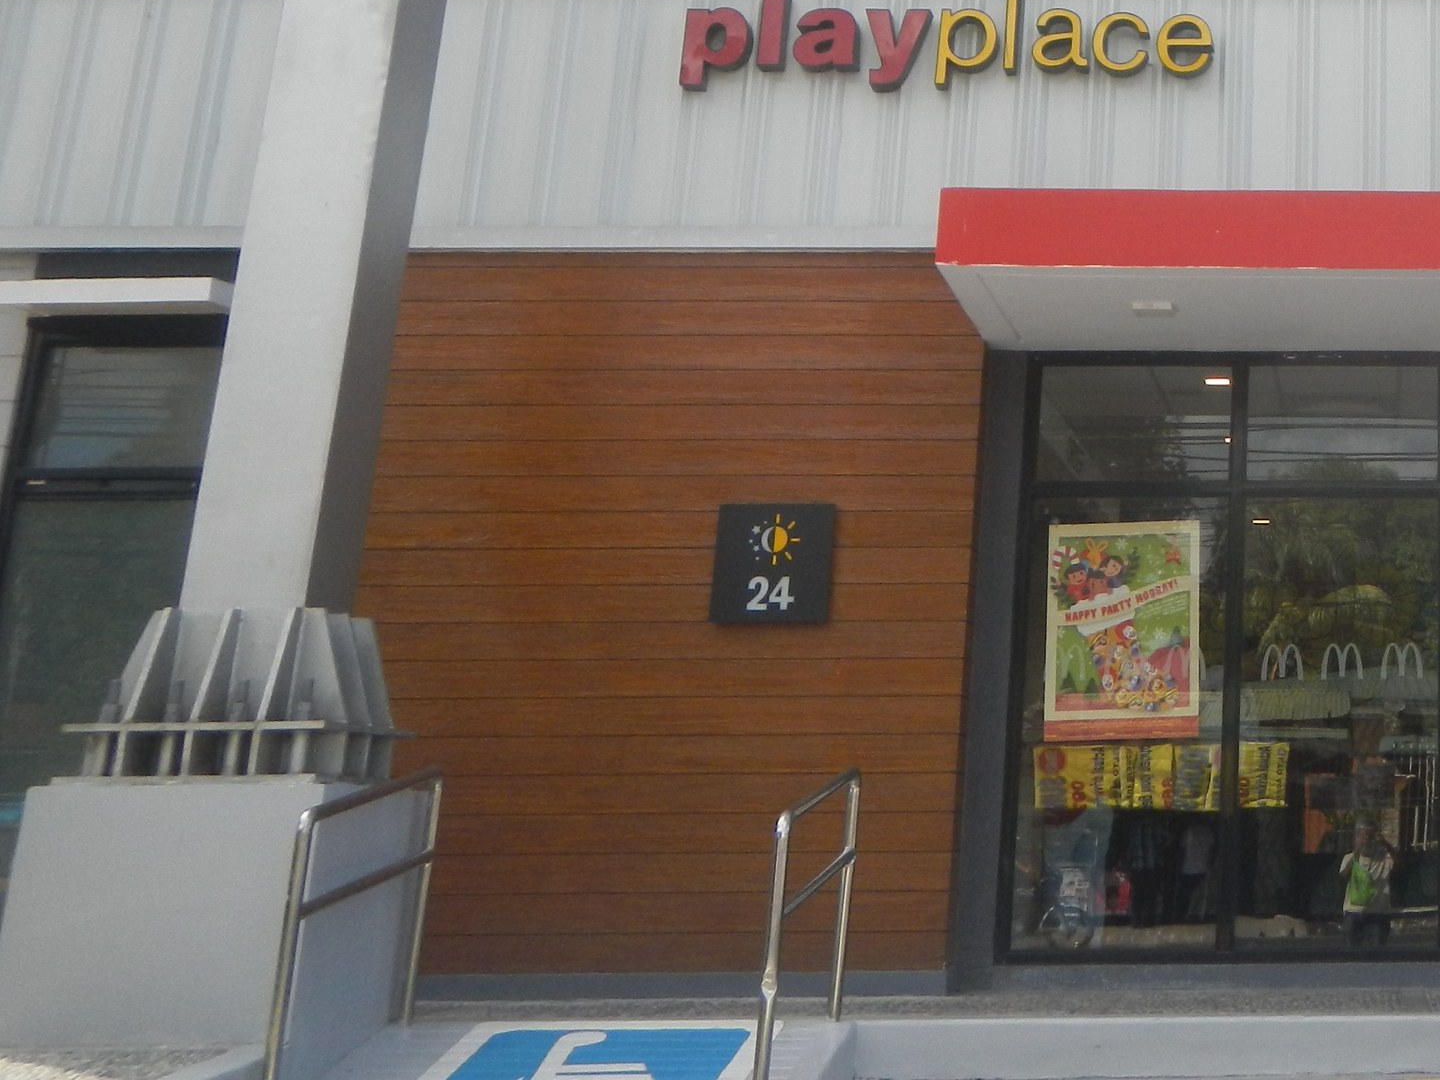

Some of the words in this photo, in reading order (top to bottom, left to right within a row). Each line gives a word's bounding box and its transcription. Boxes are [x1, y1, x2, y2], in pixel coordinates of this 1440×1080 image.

[746, 576, 795, 611] 24
[1065, 607, 1097, 622] HAPPY
[1101, 598, 1132, 616] PARTY
